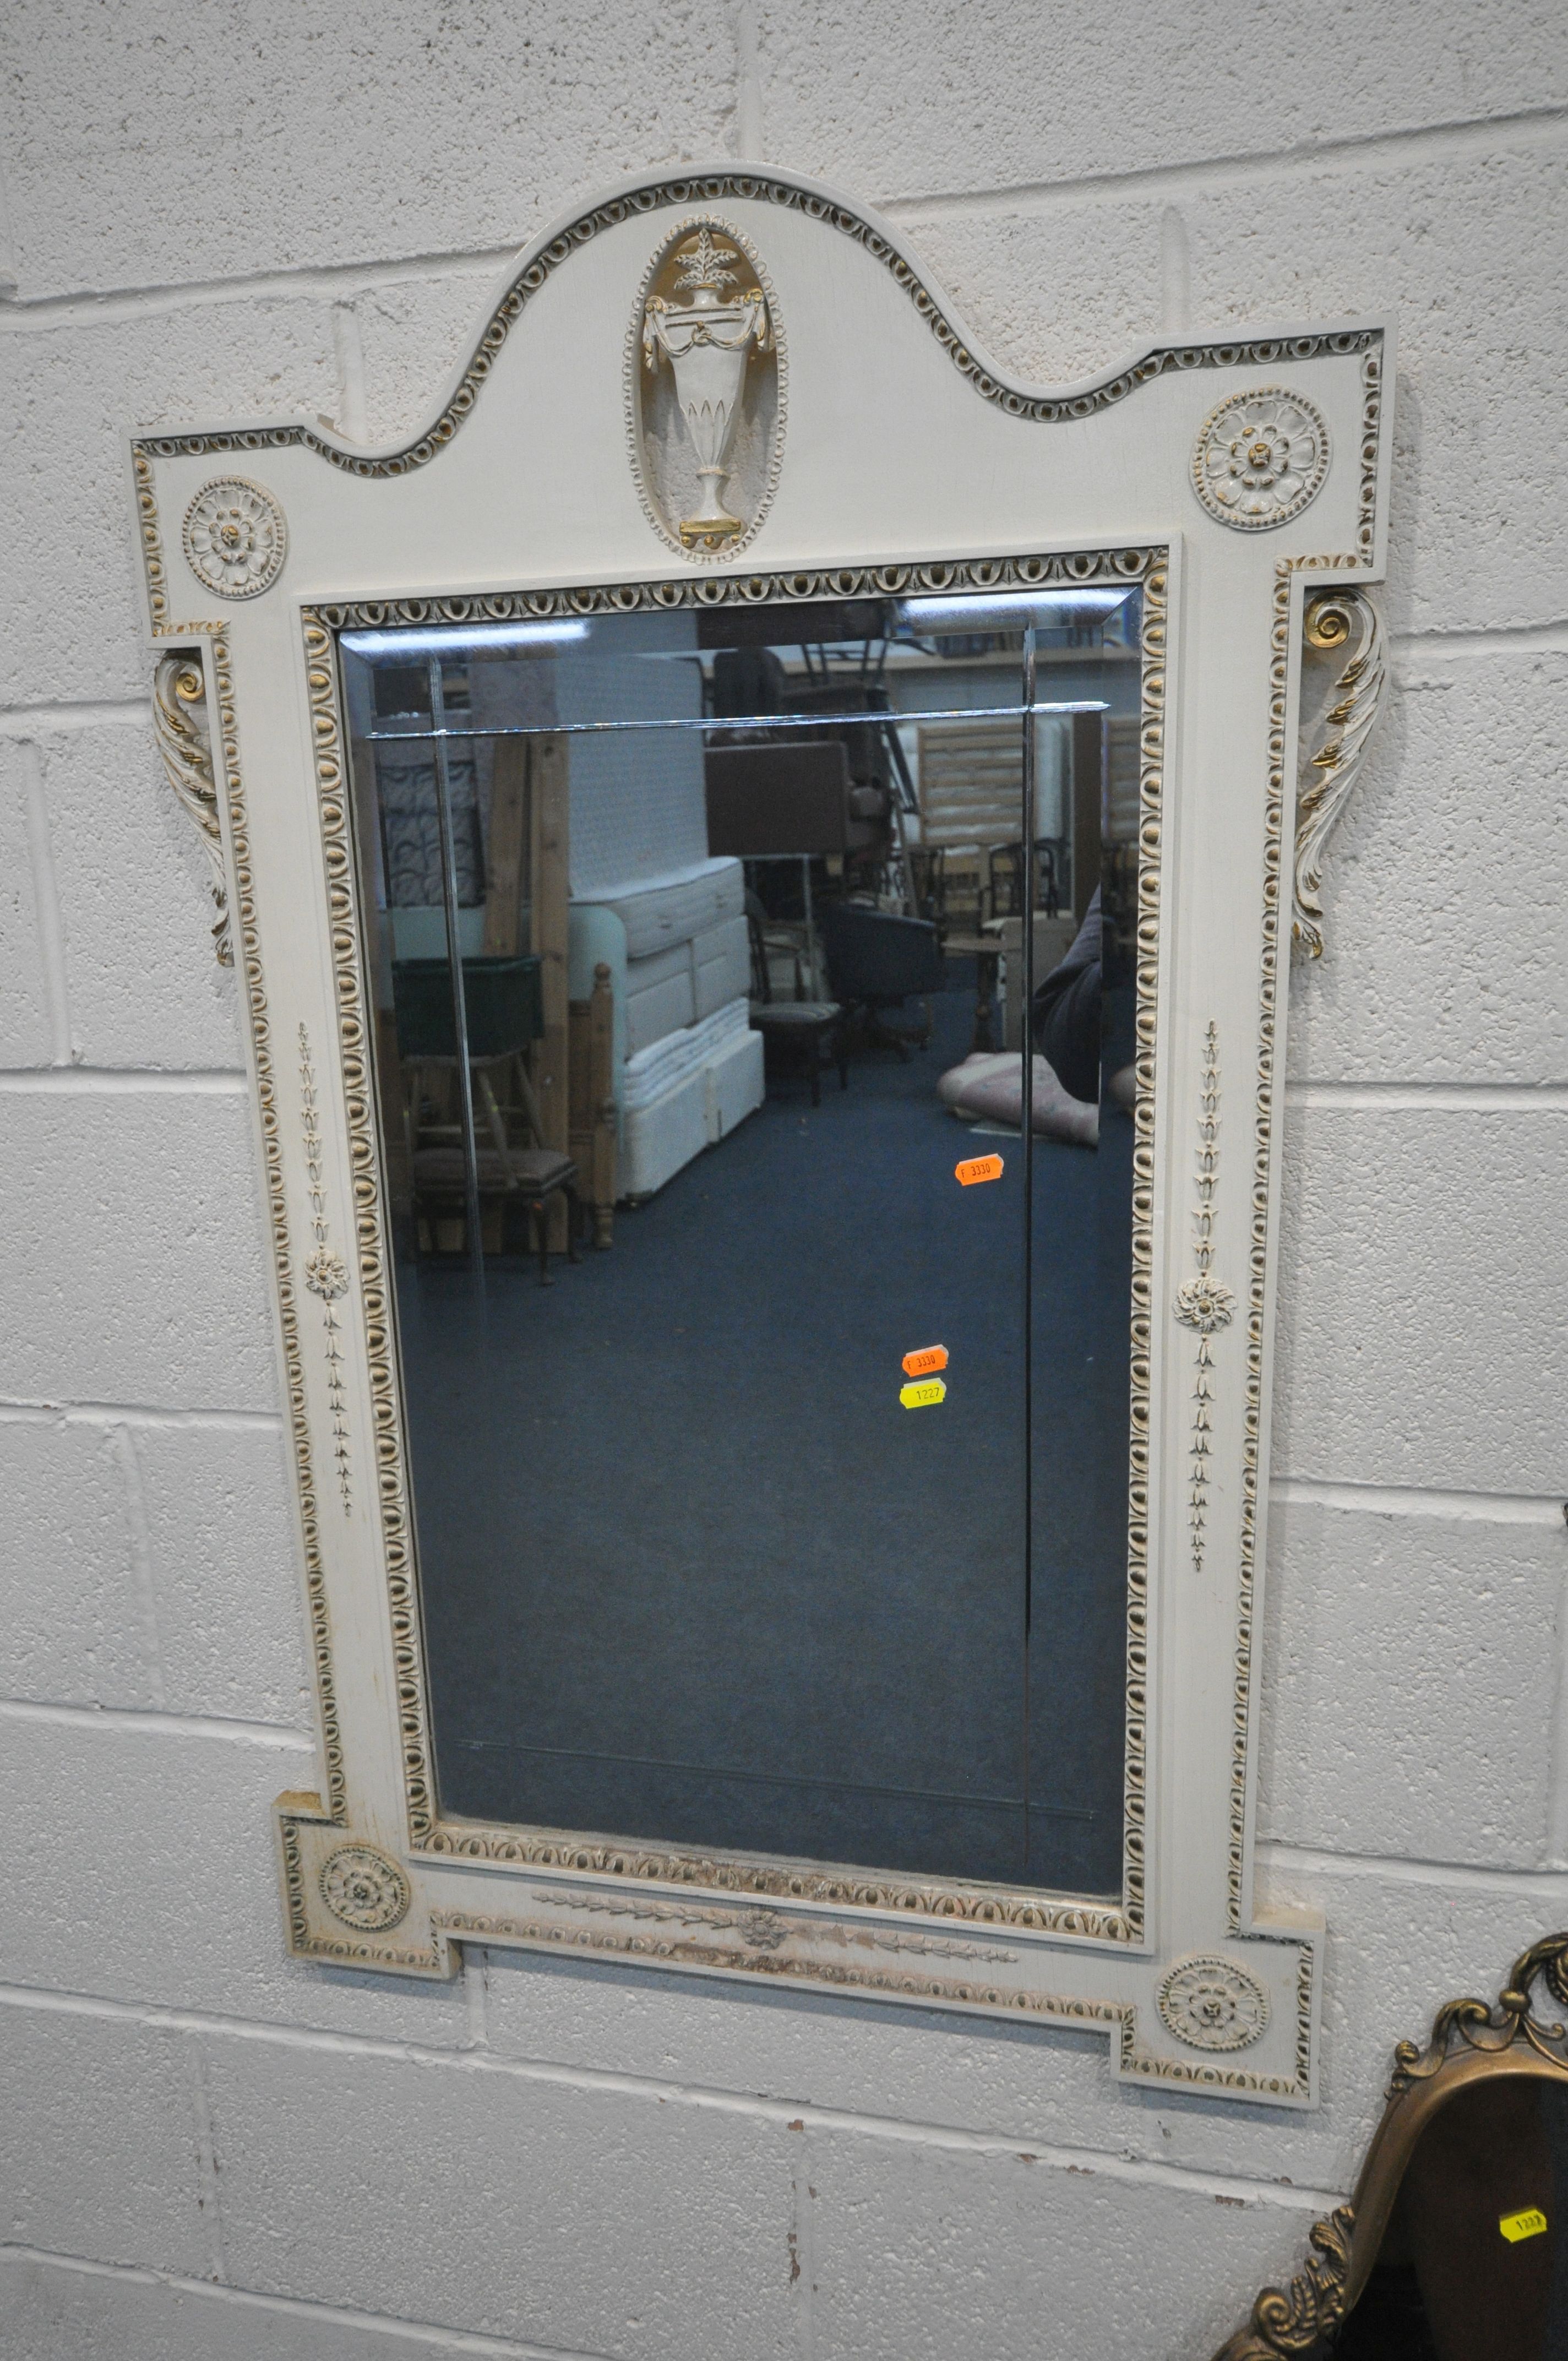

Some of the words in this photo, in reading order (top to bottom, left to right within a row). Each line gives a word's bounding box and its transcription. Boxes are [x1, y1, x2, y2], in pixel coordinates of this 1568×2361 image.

[961, 1169, 965, 1178] F
[971, 1163, 990, 1176] 3330
[907, 1361, 911, 1369] F
[917, 1355, 935, 1367] 3330
[917, 1388, 939, 1400] 1227
